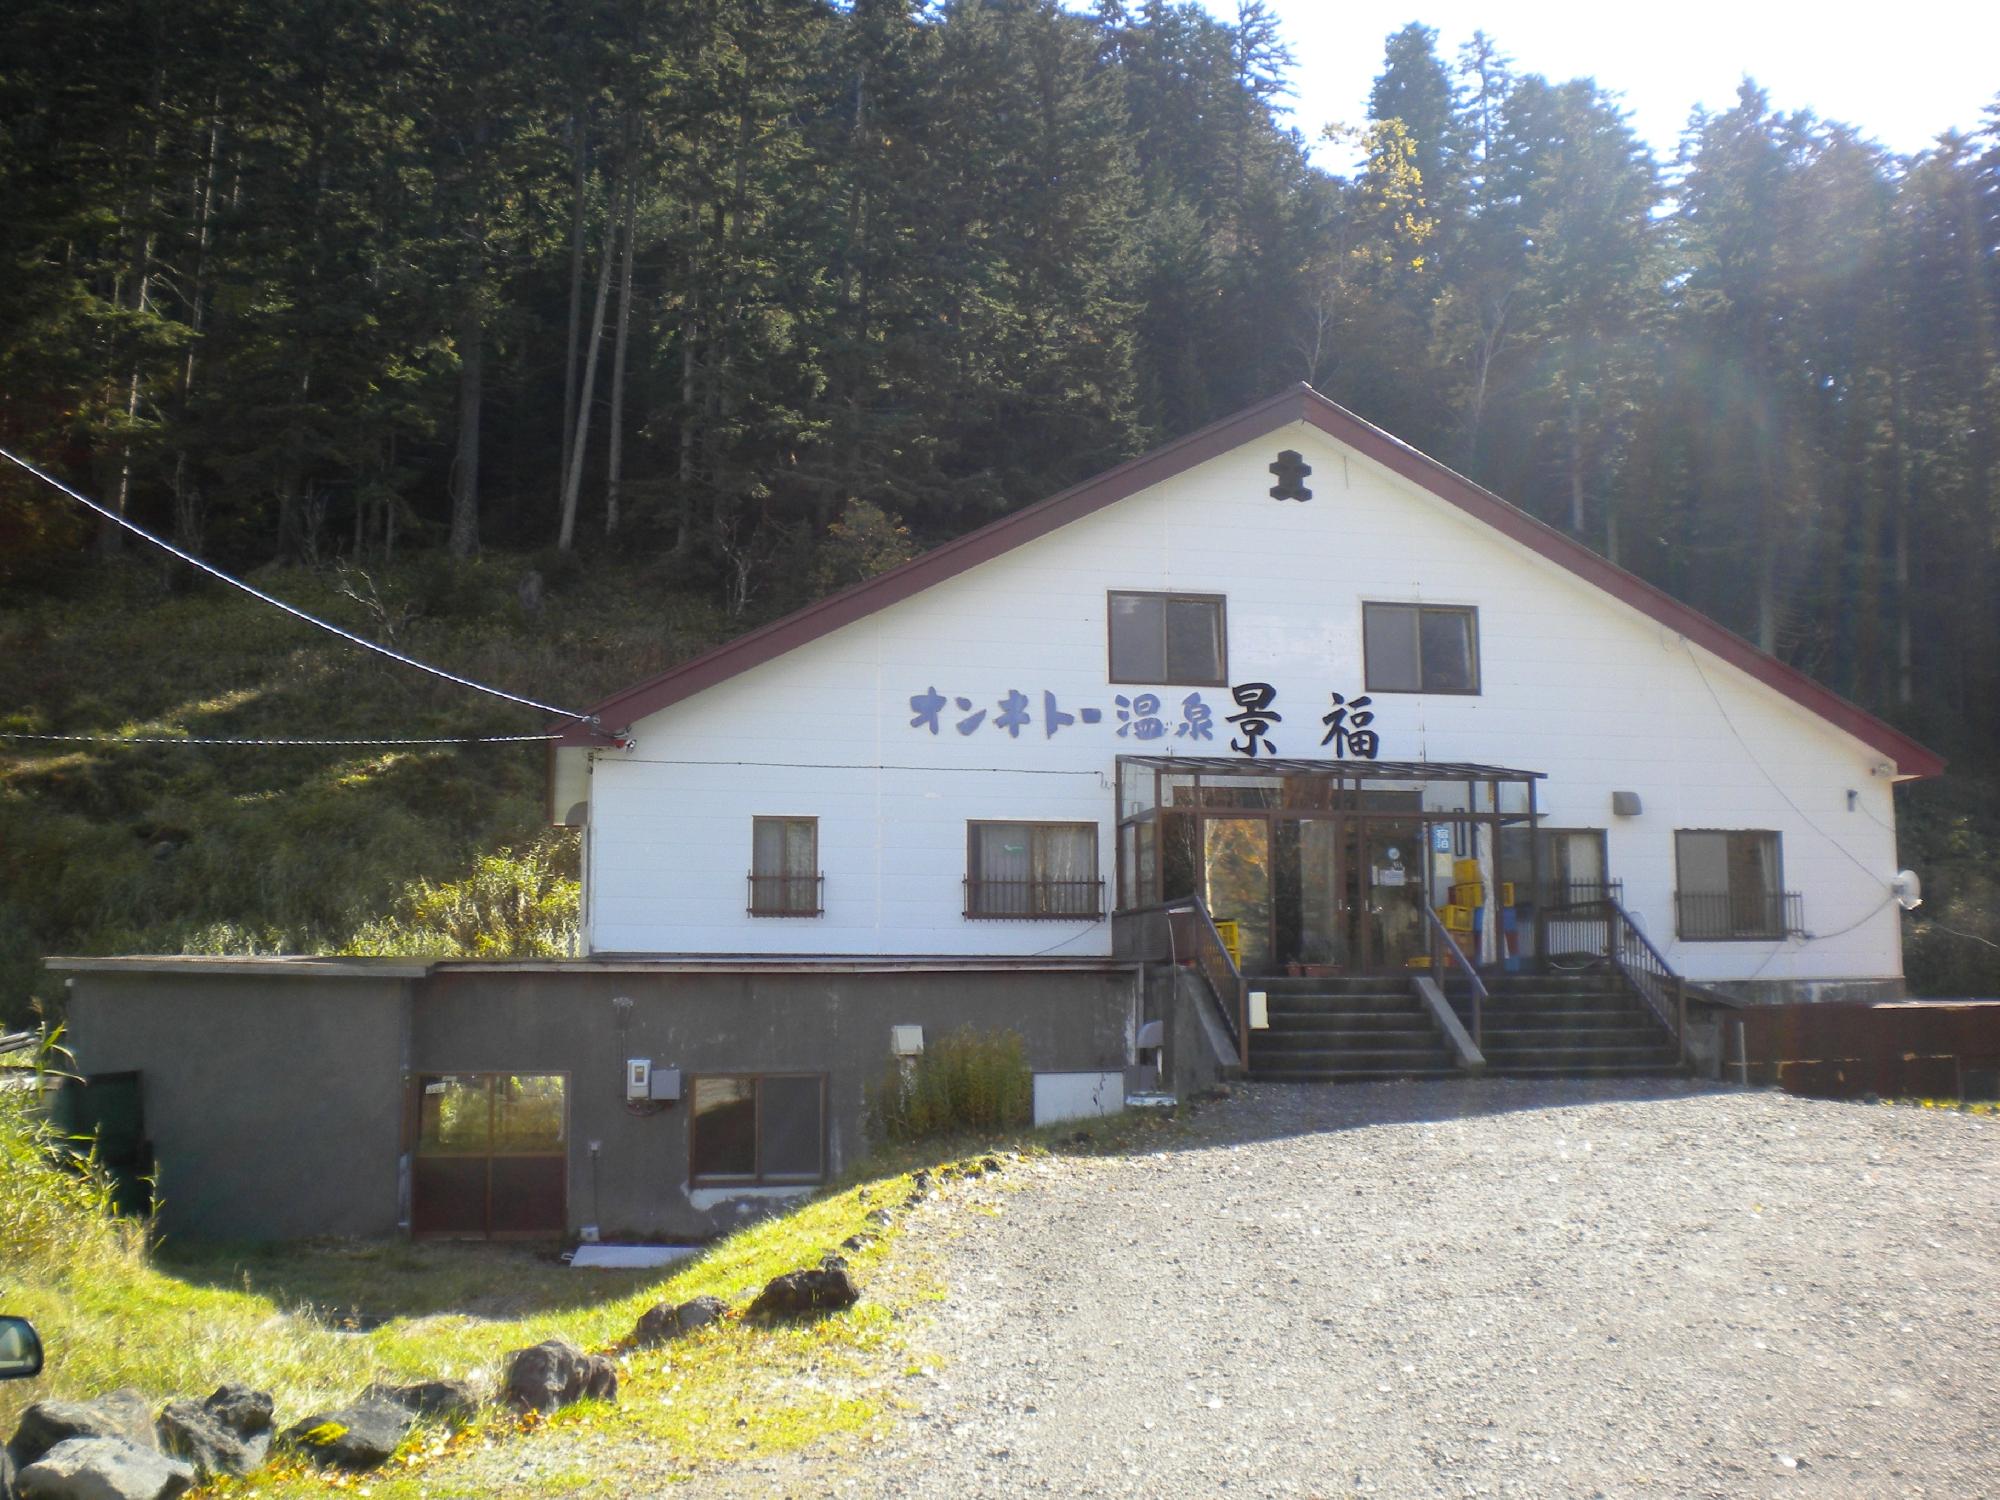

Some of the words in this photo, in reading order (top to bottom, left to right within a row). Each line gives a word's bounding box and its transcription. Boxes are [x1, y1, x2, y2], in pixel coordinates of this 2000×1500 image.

[909, 686, 1215, 742] オンネトー温泉
[1225, 682, 1380, 760] 景福
